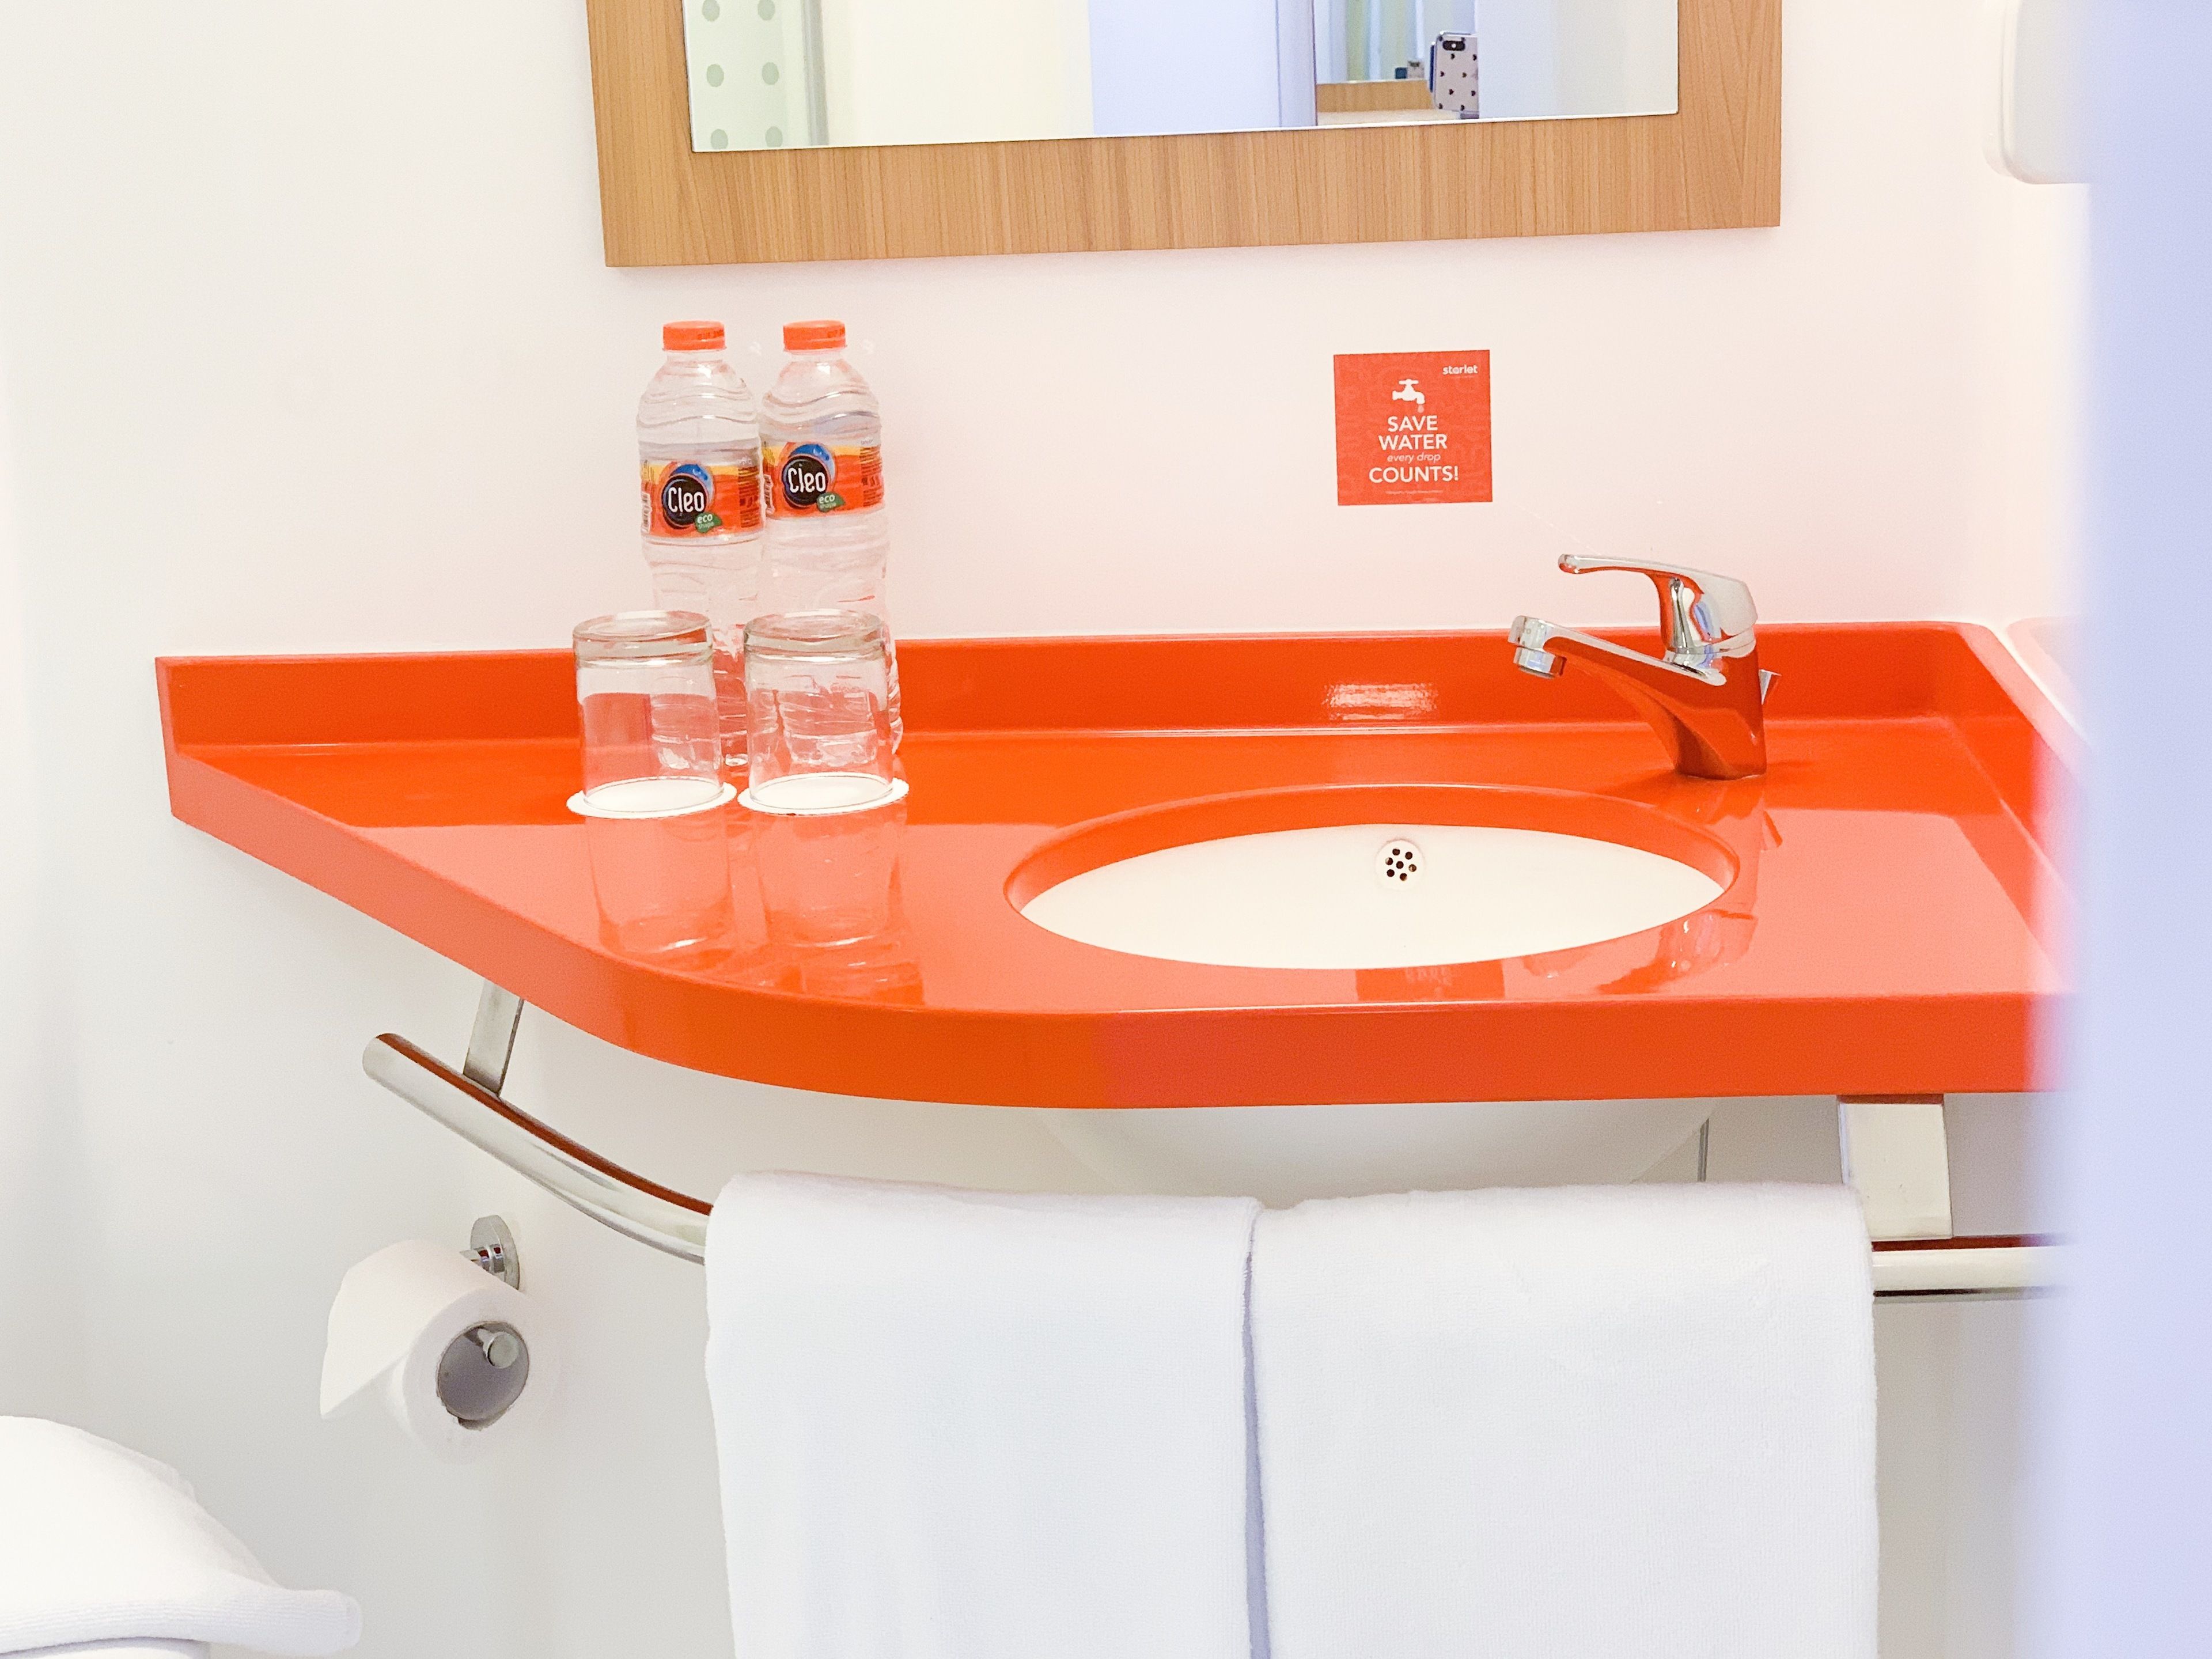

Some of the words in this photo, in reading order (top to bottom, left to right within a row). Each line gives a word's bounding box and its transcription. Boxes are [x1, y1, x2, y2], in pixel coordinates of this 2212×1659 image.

[1387, 415, 1438, 432] SAVE
[1378, 434, 1448, 450] WATER
[1387, 453, 1414, 464] every
[1416, 452, 1441, 464] drop
[787, 467, 827, 493] Cleo
[1369, 465, 1459, 483] COUNTS!
[668, 487, 704, 513] Cleo
[819, 494, 835, 504] eco
[697, 514, 713, 524] eco
